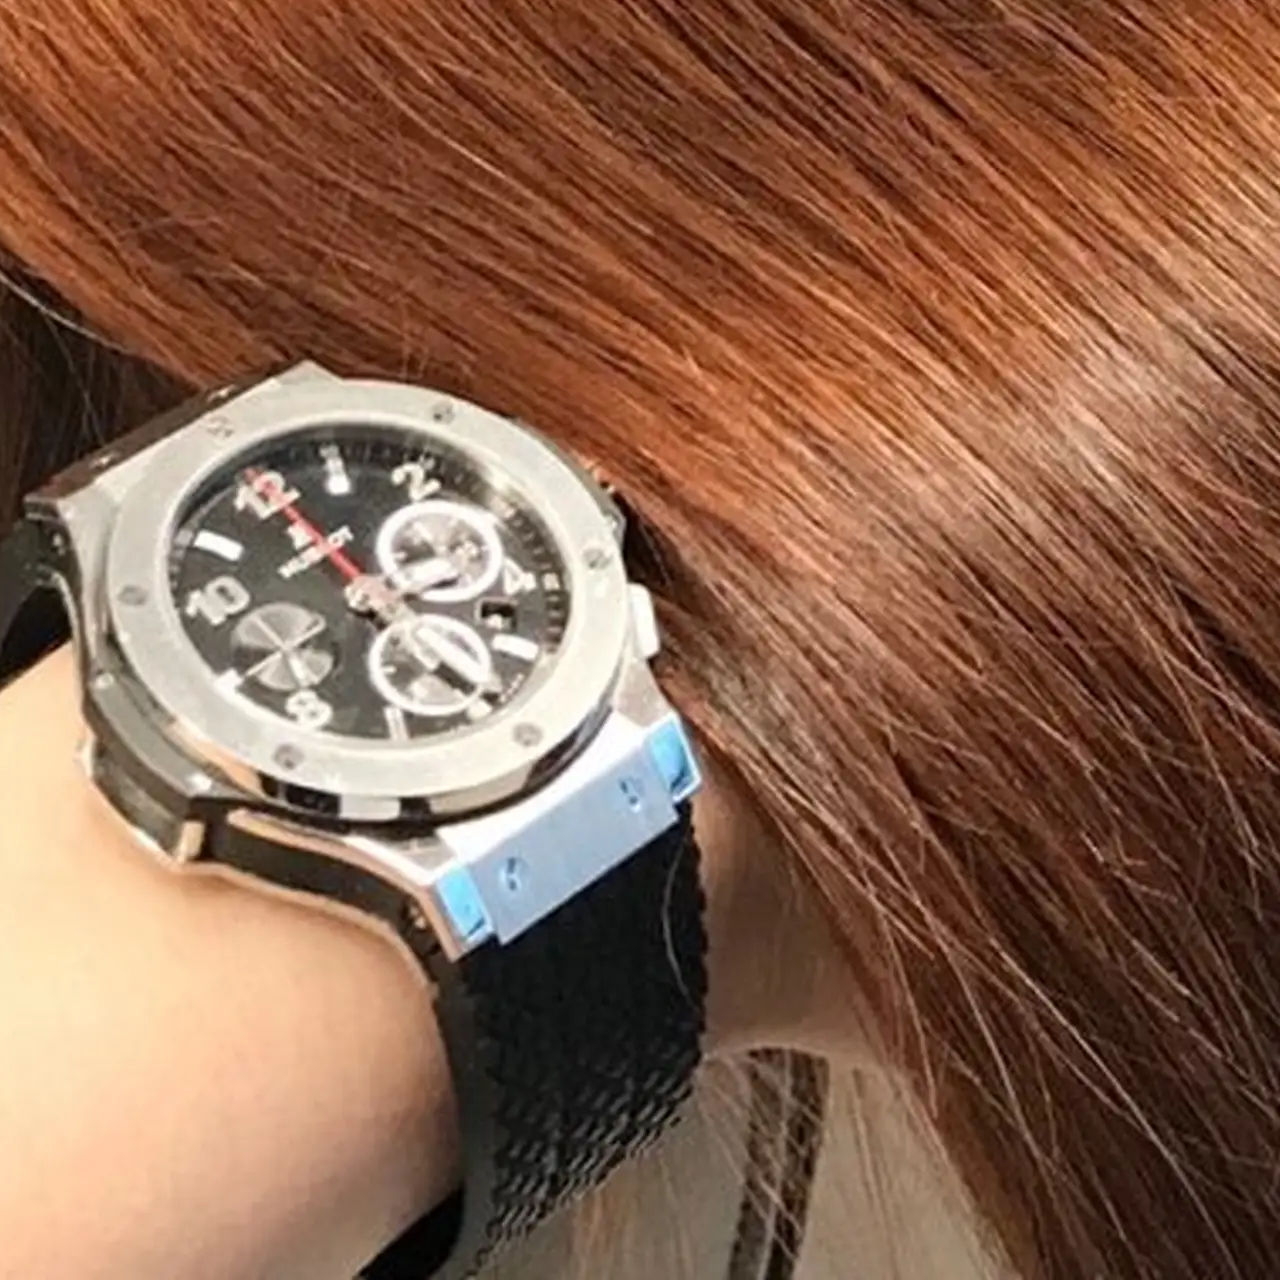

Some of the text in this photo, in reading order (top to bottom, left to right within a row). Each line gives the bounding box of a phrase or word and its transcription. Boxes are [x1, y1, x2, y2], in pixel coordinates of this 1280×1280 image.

[234, 470, 301, 520] 12
[186, 576, 251, 626] 10
[286, 690, 333, 729] 8
